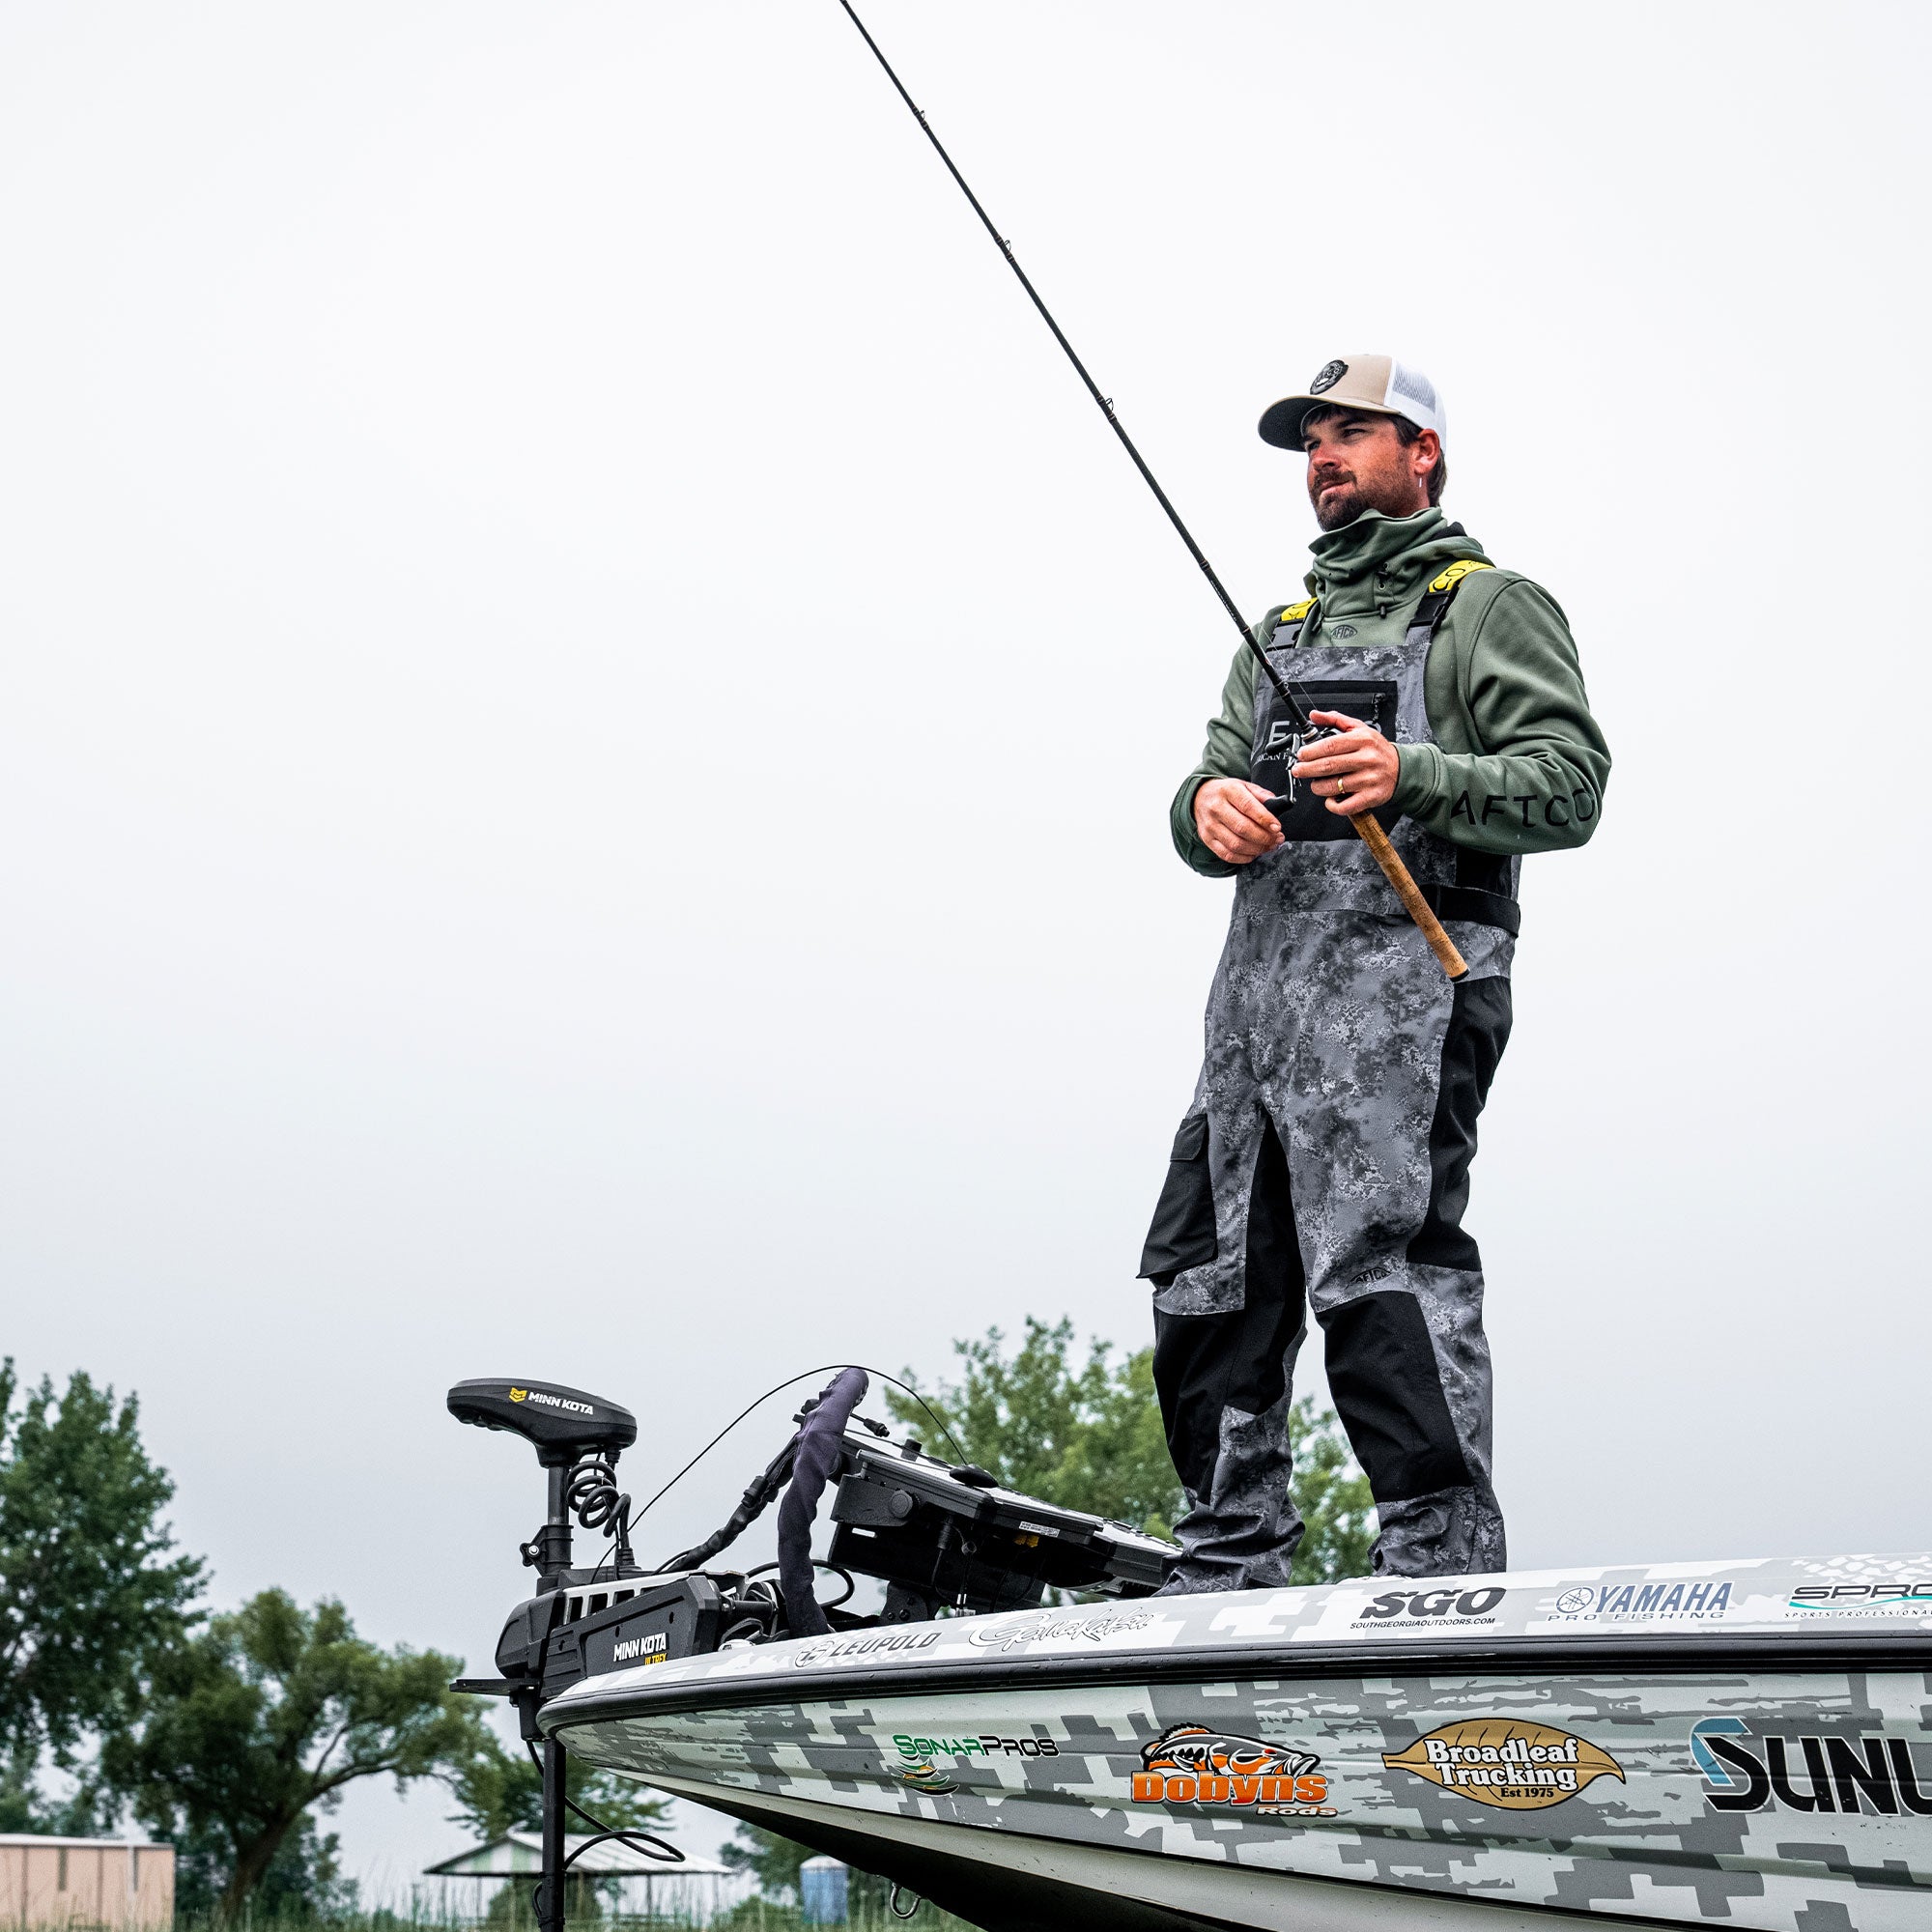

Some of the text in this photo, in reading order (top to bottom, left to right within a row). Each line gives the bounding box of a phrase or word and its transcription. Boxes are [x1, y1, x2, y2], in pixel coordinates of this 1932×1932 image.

[1450, 789, 1596, 828] AFTCO
[528, 1392, 594, 1415] MINN KOTA
[1359, 1586, 1507, 1619] SGO
[1596, 1582, 1733, 1613] YAMAHA
[1350, 1617, 1496, 1630] SOUTHGEORGIAOUTDOORS.COM
[1614, 1611, 1724, 1620] FISHING
[613, 1633, 667, 1662] MINN KOTA
[829, 1633, 942, 1657] LEUPOLD
[1424, 1737, 1578, 1764] Broadleaf
[1131, 1771, 1329, 1805] Dobyns
[1436, 1763, 1577, 1791] Trucking
[1501, 1788, 1553, 1798] Est 1975
[1257, 1805, 1338, 1816] Rods
